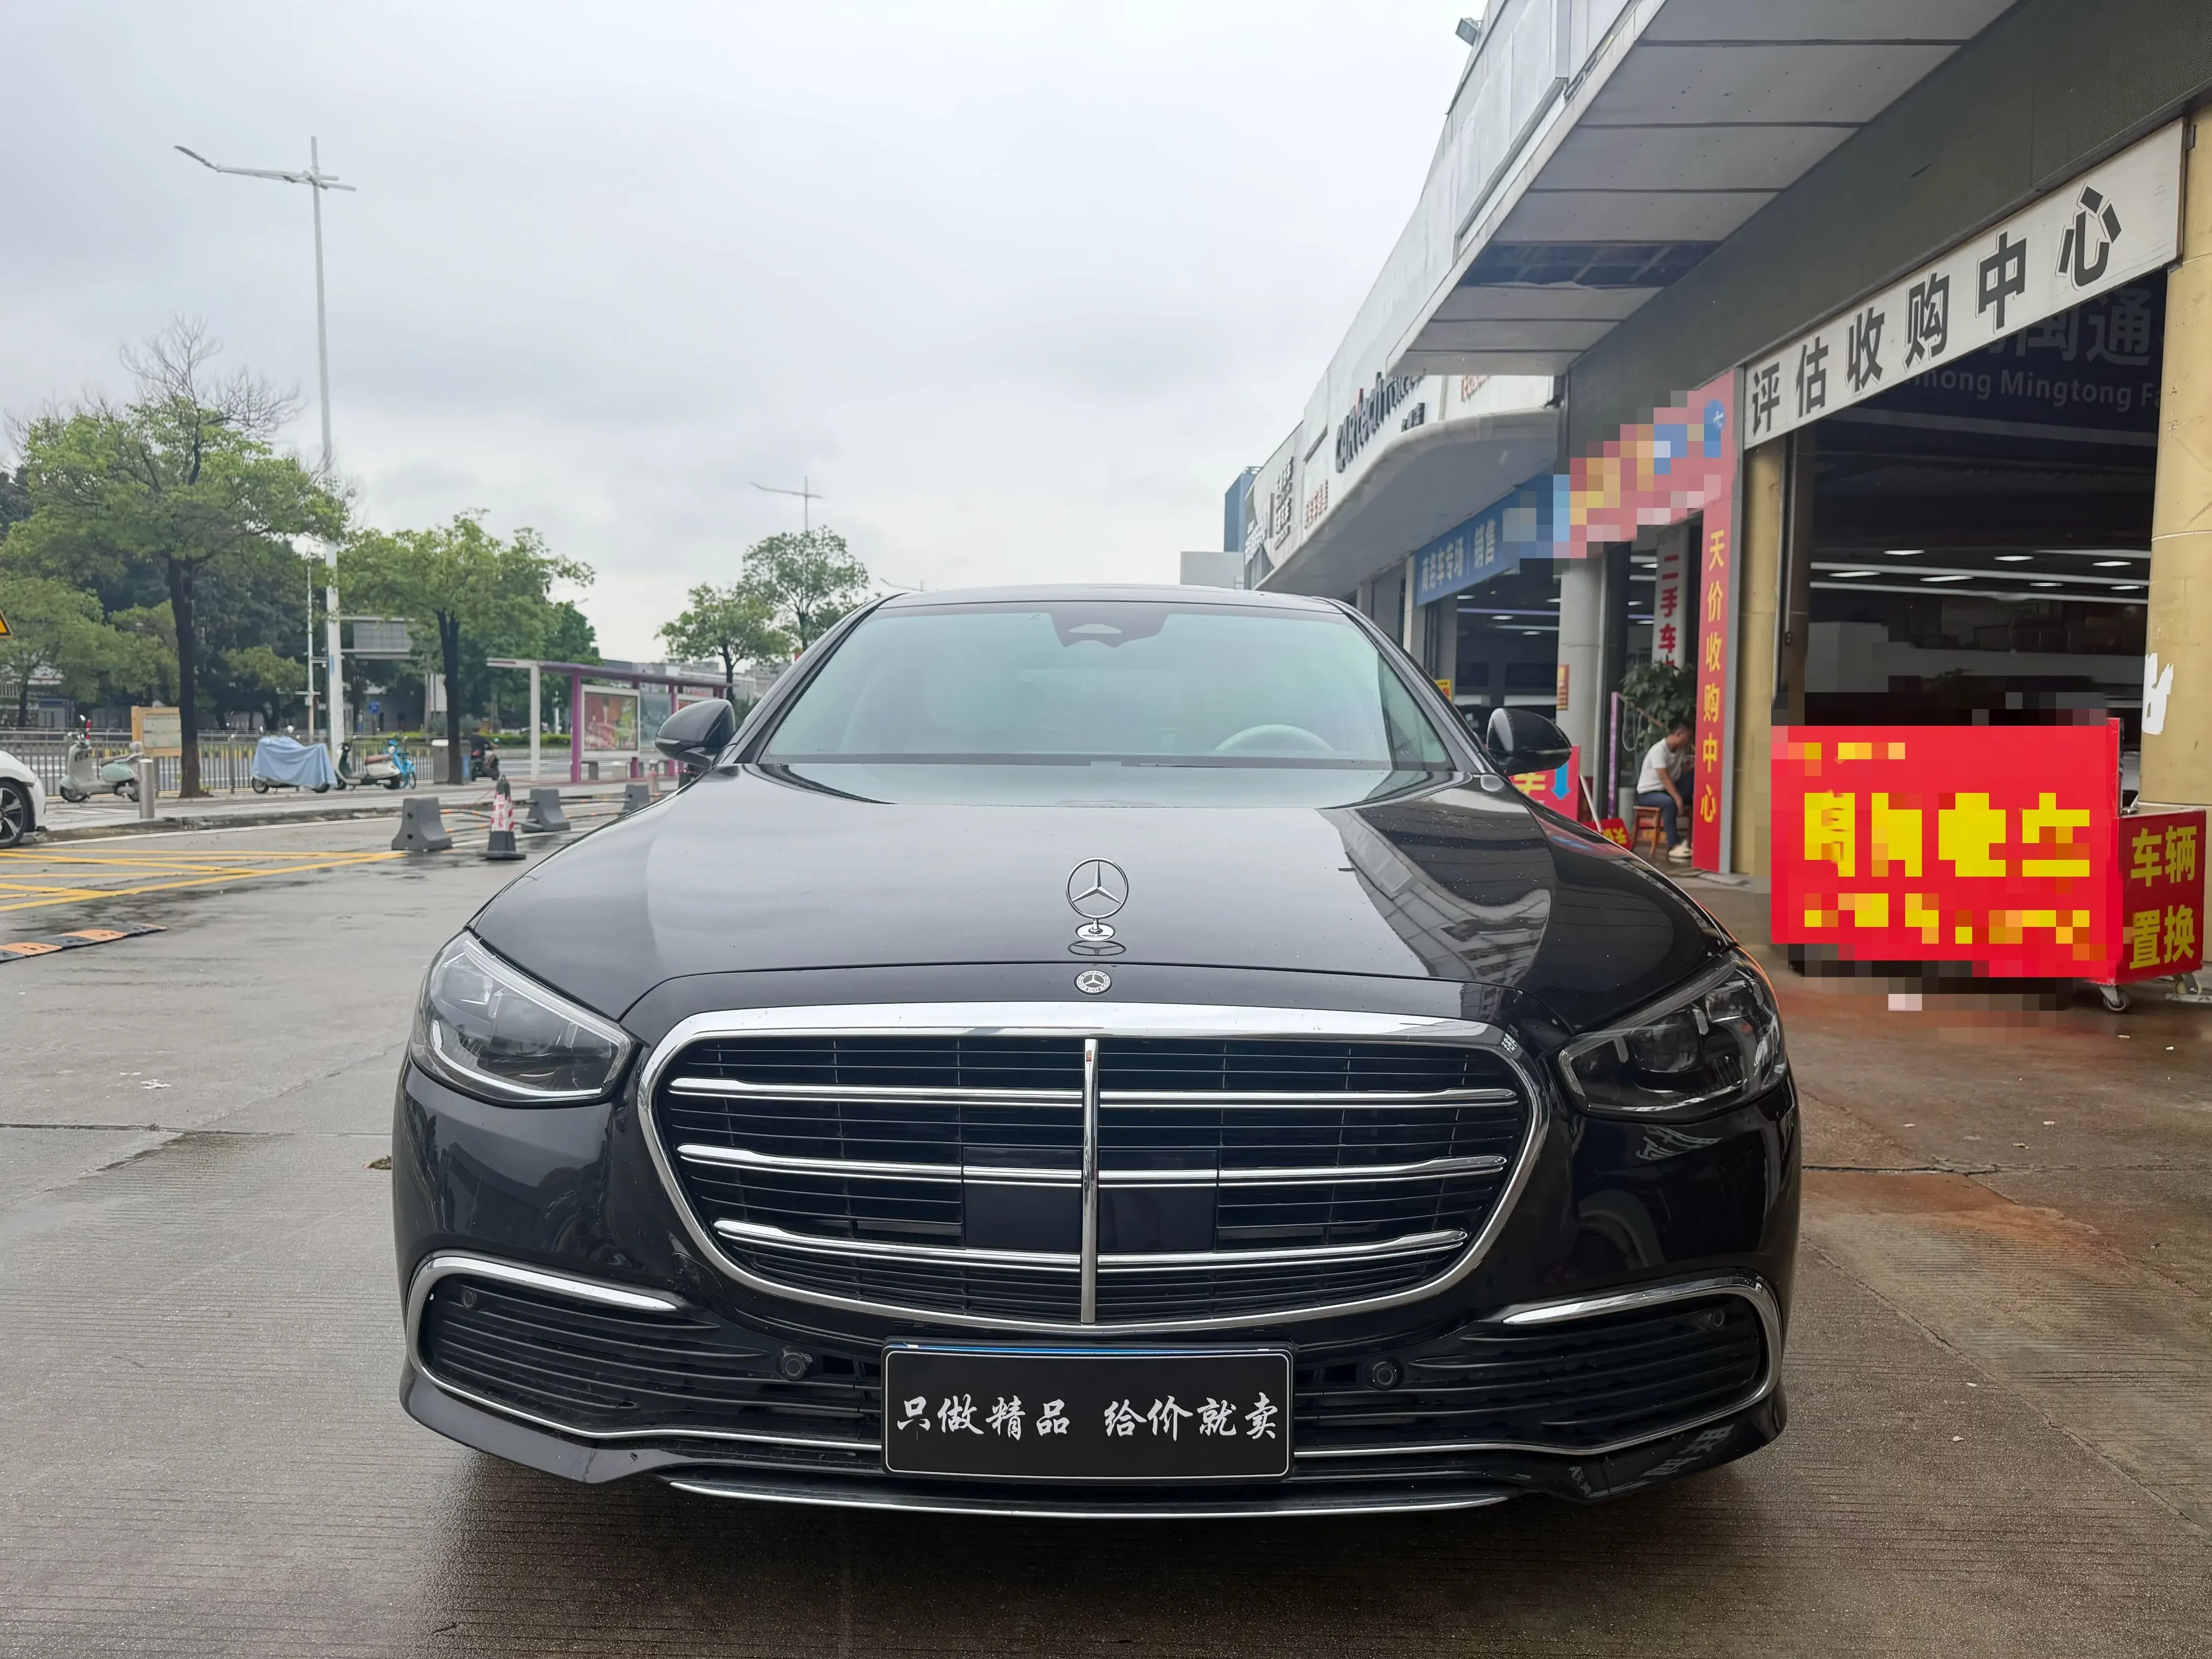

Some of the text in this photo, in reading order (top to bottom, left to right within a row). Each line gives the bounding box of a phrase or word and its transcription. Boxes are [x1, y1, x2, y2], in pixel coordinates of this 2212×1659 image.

[1752, 186, 2122, 436] 评估收购中心
[2000, 369, 2131, 412] Mingtong
[1658, 554, 1679, 666] 二手车
[1700, 529, 1726, 824] 天价收购中心
[2129, 825, 2197, 888] 车辆
[2129, 904, 2195, 970] 置换
[896, 1391, 1278, 1442] 只做精品 给价就卖
